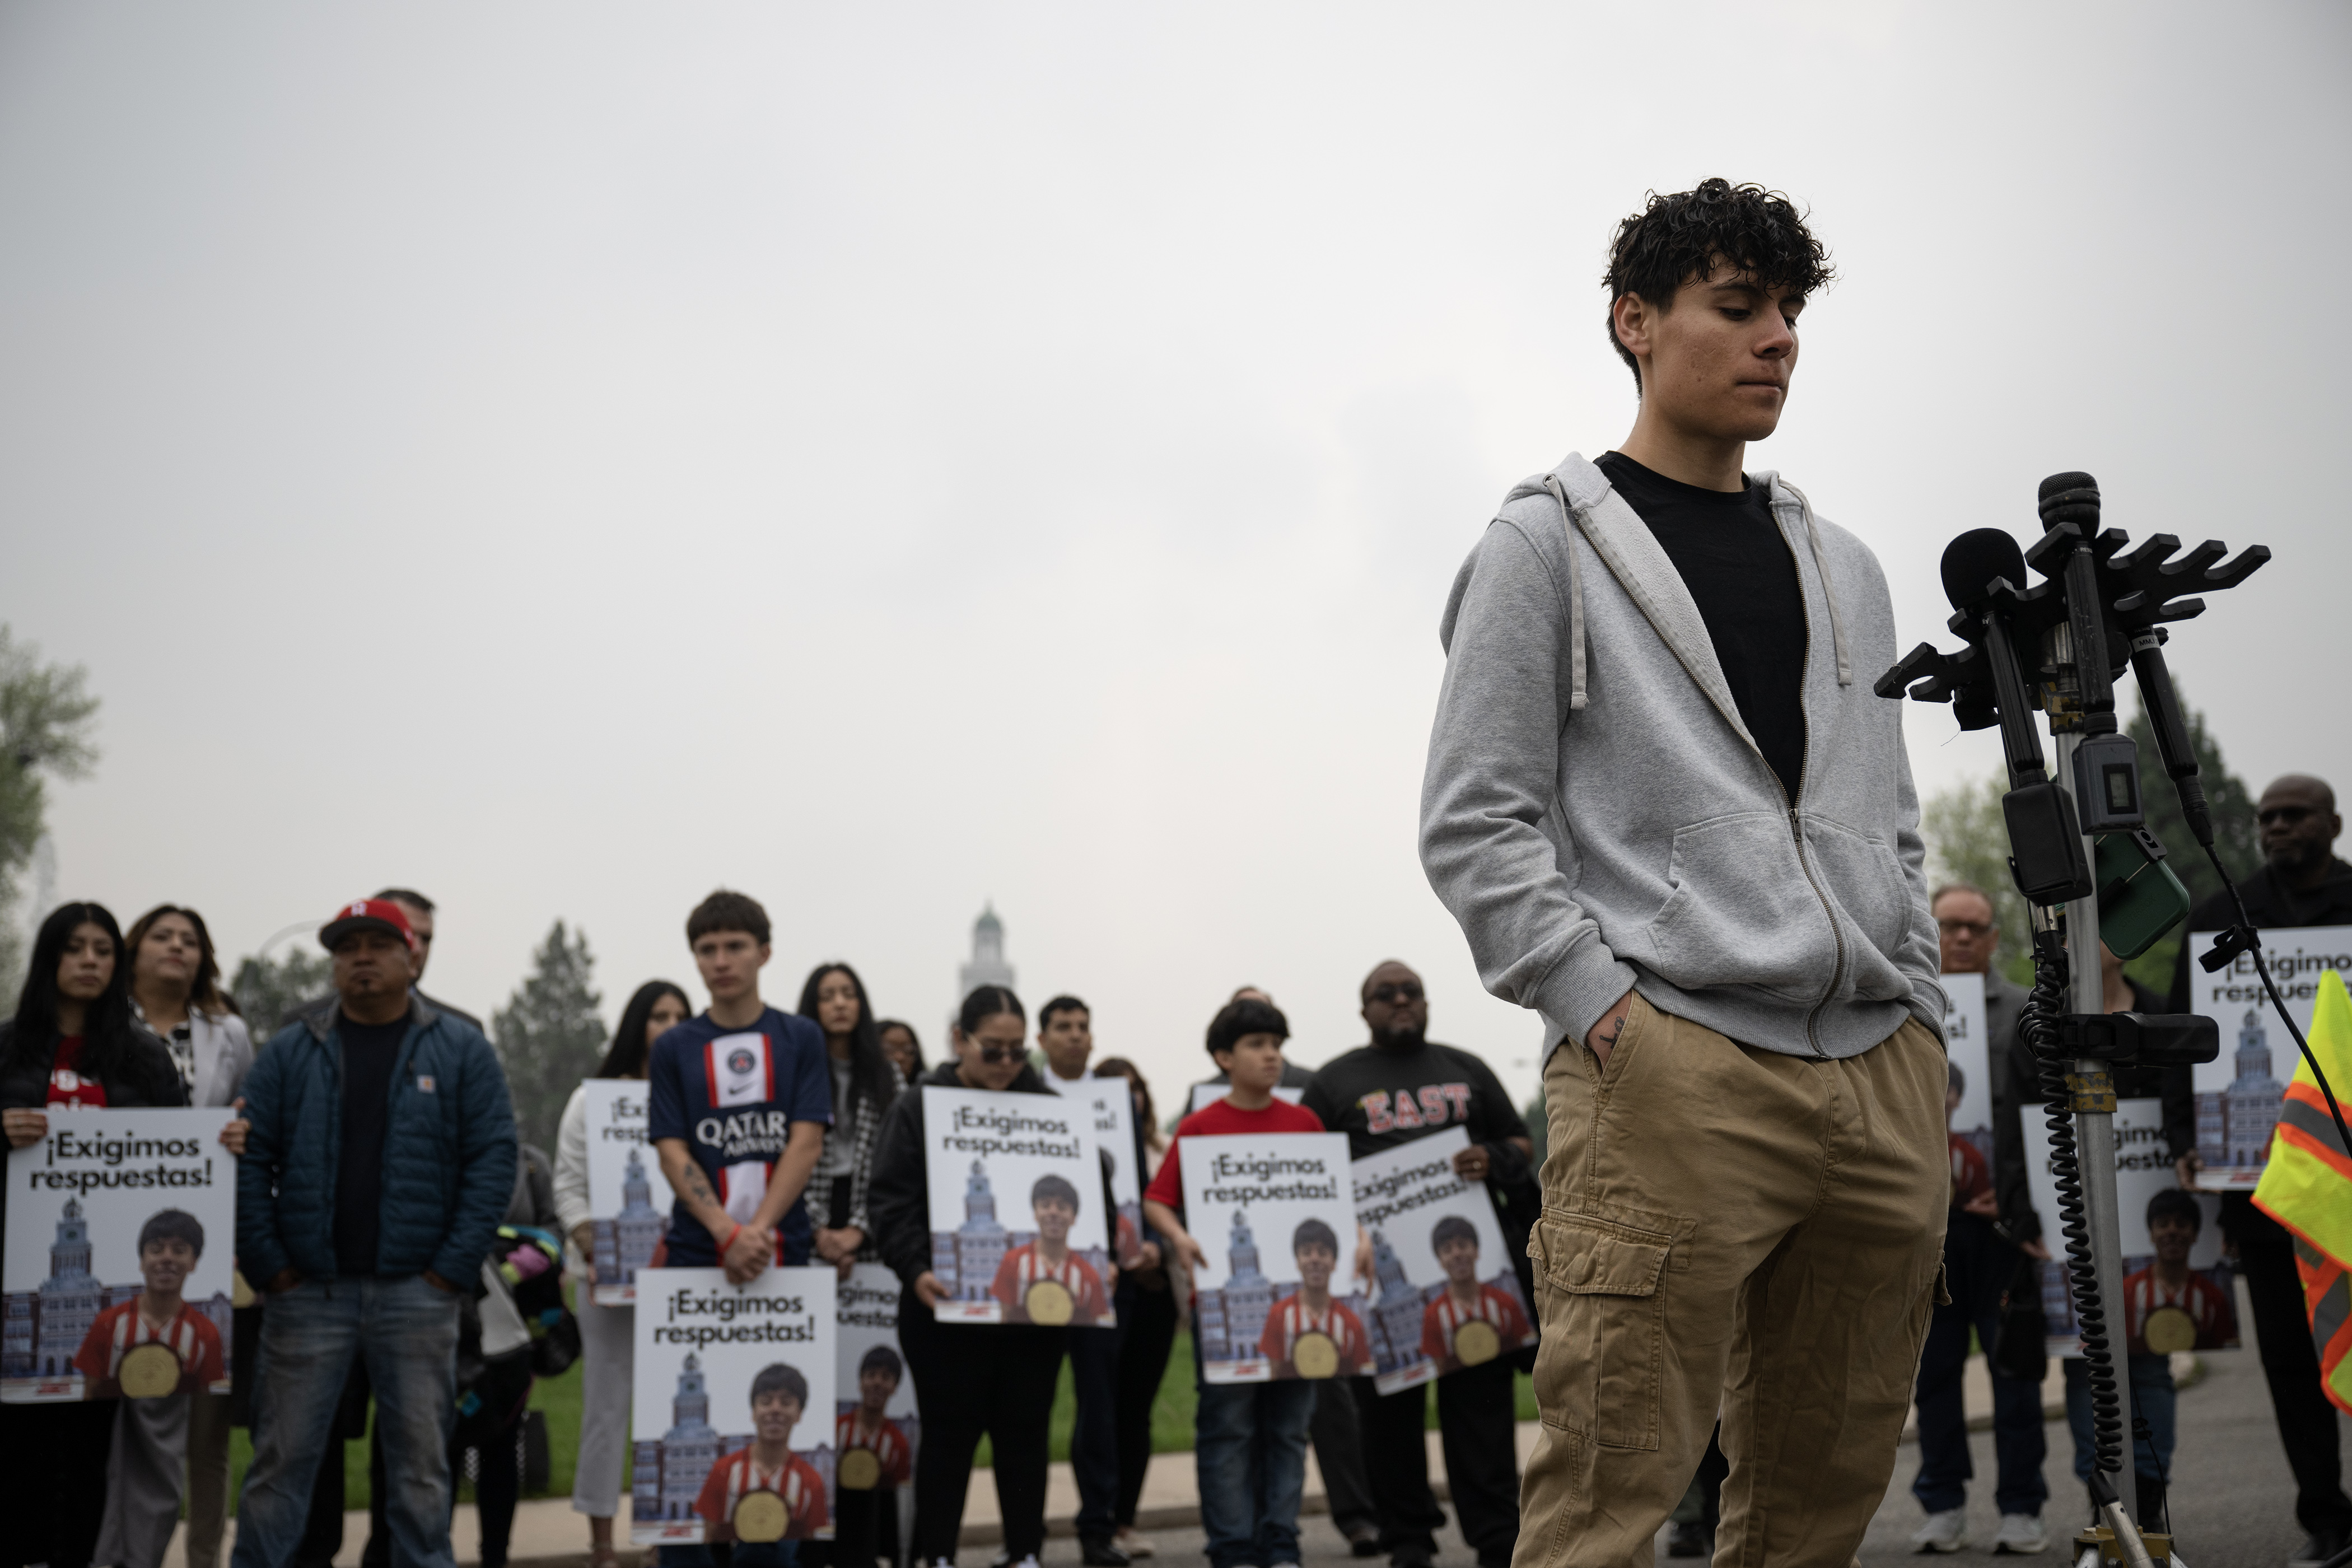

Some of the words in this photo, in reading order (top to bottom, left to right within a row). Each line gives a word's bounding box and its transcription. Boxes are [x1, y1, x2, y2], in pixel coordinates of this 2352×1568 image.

[953, 1105, 1068, 1135] ¡Exigimos
[1360, 1082, 1472, 1135] EAST
[696, 1110, 787, 1149] QATAR
[46, 1130, 200, 1165] ¡Exigimos
[942, 1136, 1081, 1159] respuestas!
[30, 1159, 212, 1196] respuestas!
[1211, 1151, 1325, 1183] ¡Exigimos
[1202, 1175, 1338, 1207] respuestas!
[668, 1288, 803, 1322] ¡Exigimos
[654, 1315, 815, 1351] respuestas!
